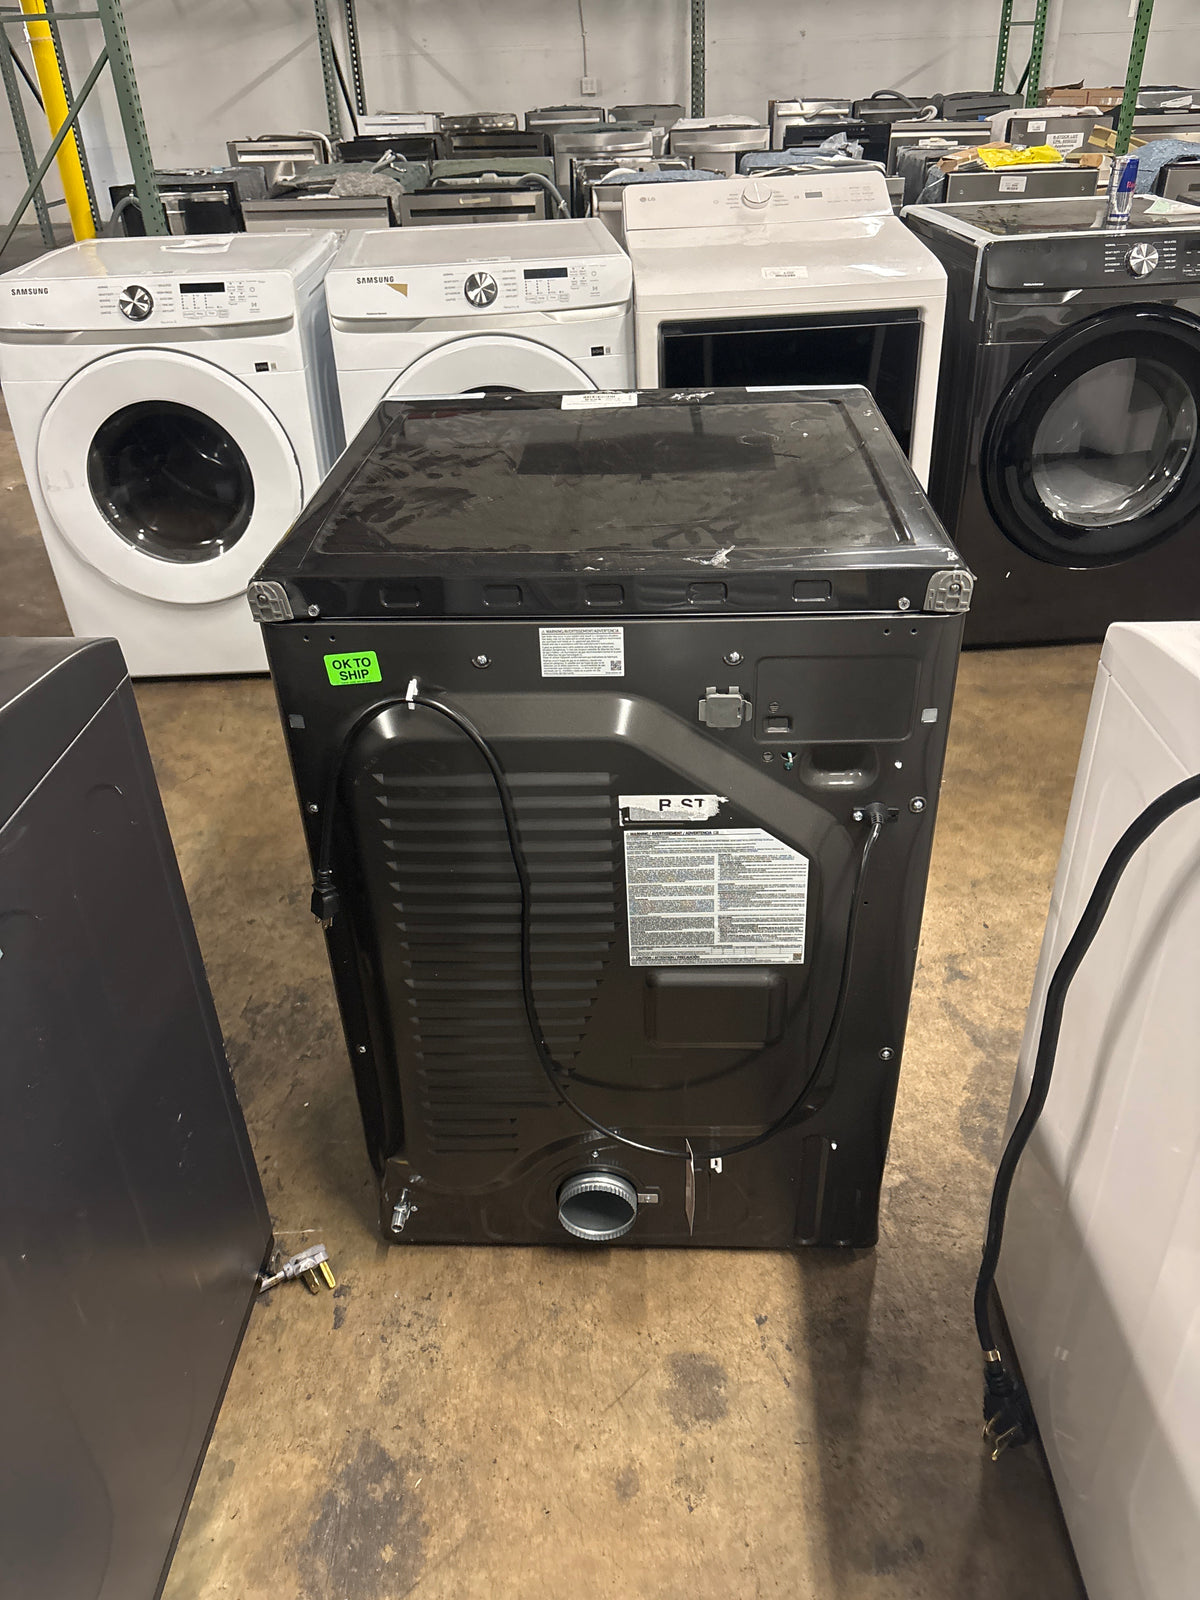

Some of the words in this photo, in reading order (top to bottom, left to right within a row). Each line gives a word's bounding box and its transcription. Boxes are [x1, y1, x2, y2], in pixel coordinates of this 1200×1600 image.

[356, 275, 394, 284] SAMSUNG
[11, 288, 49, 296] SAMSUNG
[332, 658, 352, 670] OK
[352, 657, 371, 668] TO
[339, 669, 369, 681] SHIP
